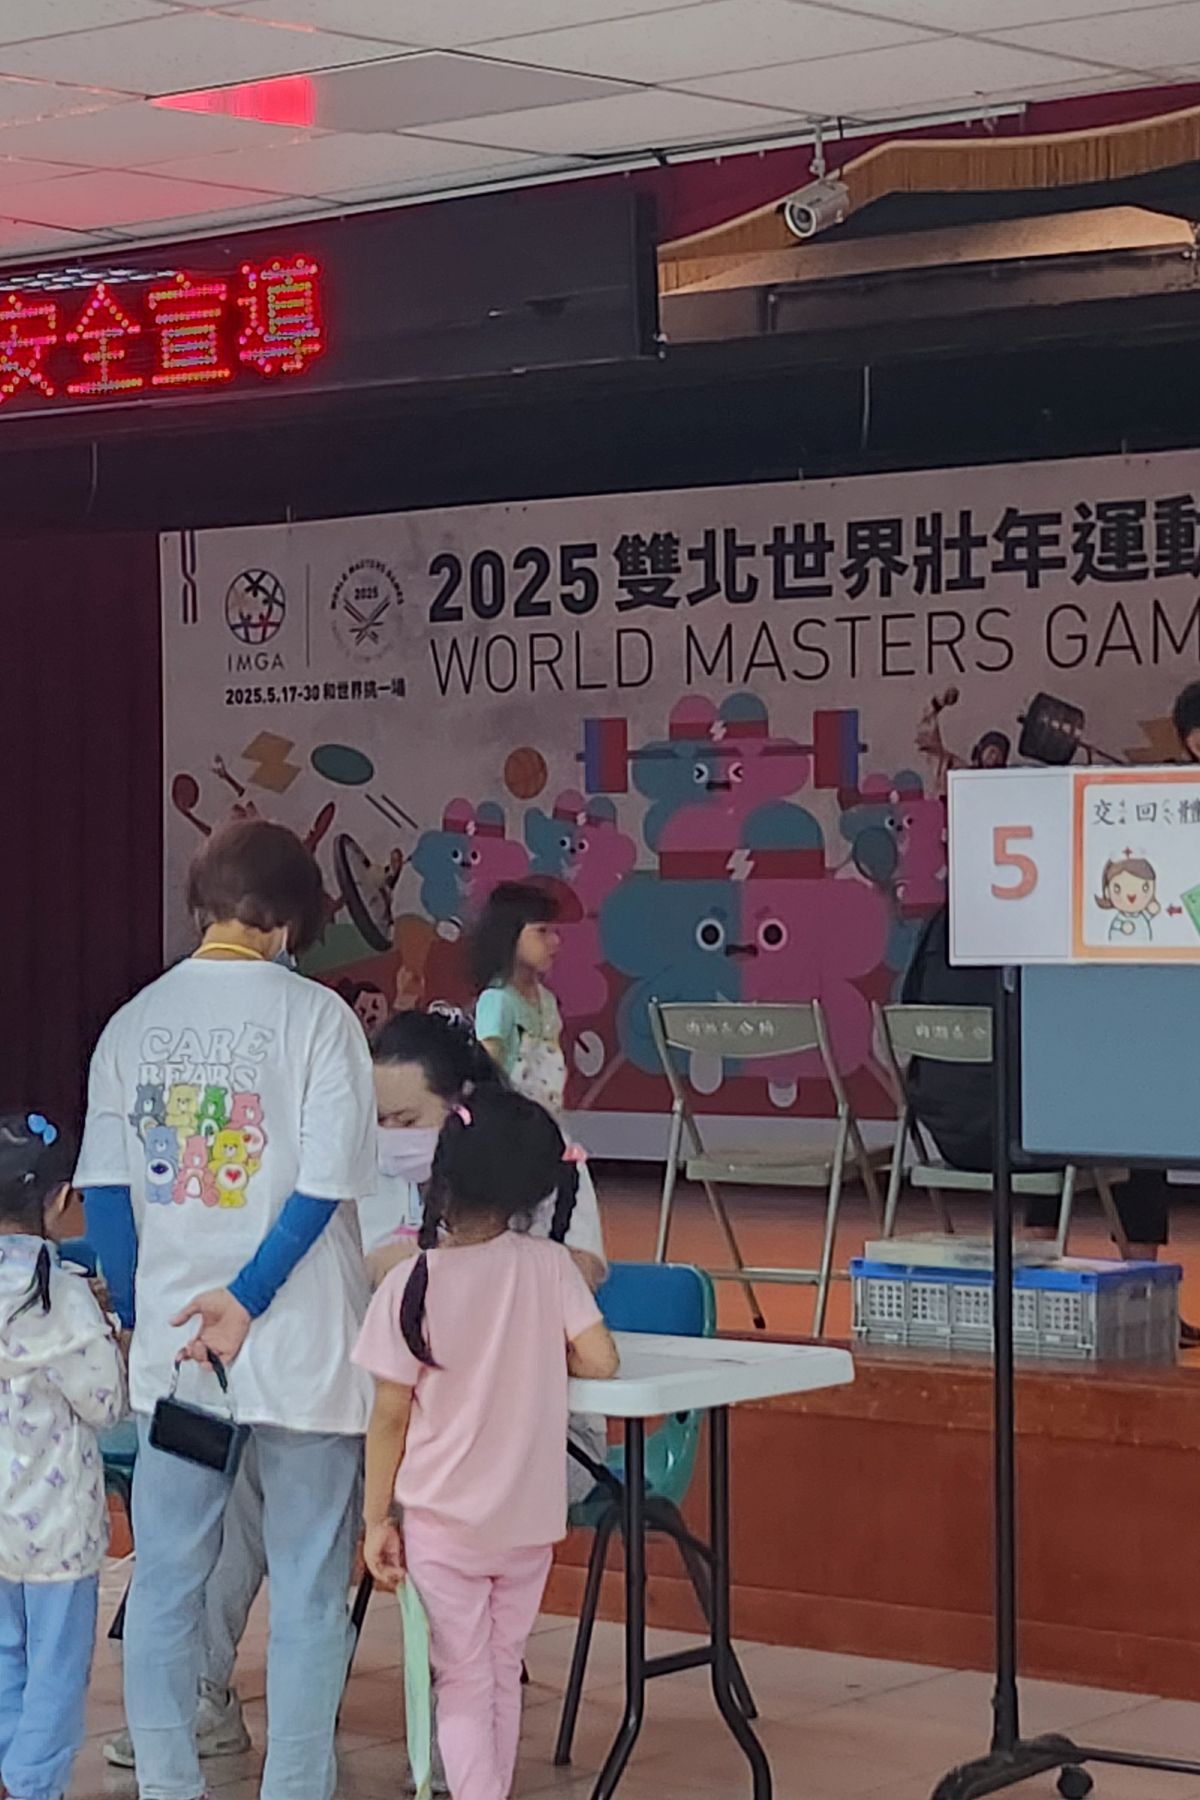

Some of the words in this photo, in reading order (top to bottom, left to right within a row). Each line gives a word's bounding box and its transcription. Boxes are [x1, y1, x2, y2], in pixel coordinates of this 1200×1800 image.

[227, 652, 285, 672] IMGA
[430, 628, 652, 696] WORLD
[686, 608, 1014, 685] MASTERS
[990, 827, 1039, 900] 5
[141, 1022, 276, 1064] CARE
